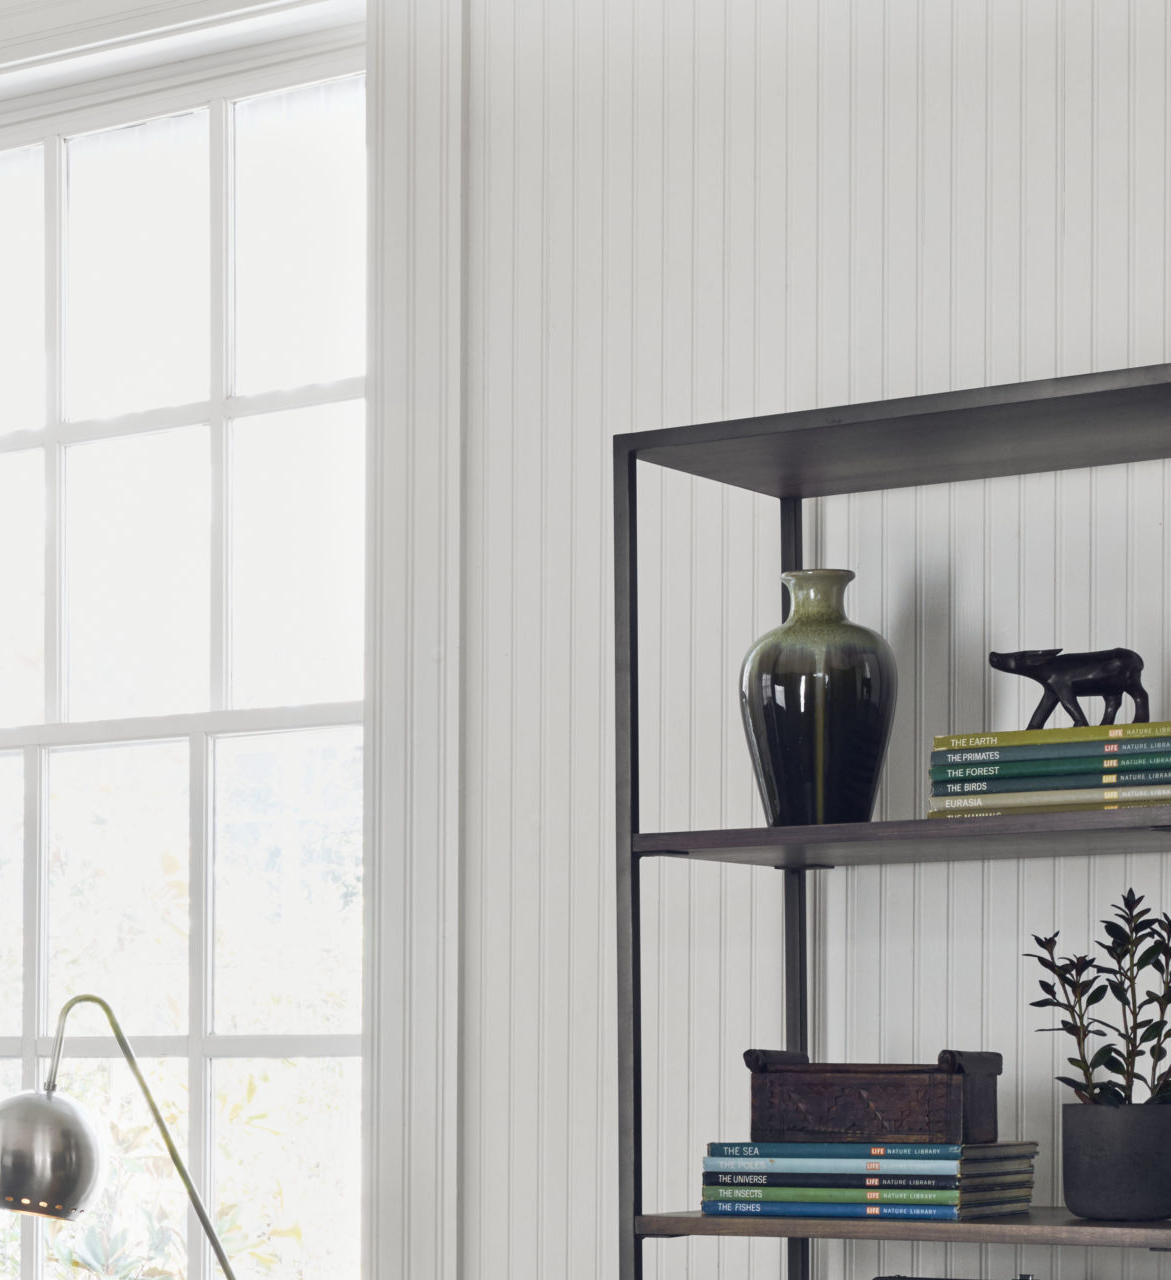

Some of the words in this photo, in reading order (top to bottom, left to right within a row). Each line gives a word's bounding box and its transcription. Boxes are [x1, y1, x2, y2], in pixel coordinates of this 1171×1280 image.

[950, 739, 967, 747] THE
[969, 737, 997, 746] EARTH
[1105, 744, 1118, 752] LIFE
[946, 753, 961, 762] THE
[962, 751, 1000, 761] PRIMATES
[947, 769, 964, 777] THE
[966, 766, 999, 776] FOREST
[1103, 775, 1116, 783] LIFE
[947, 784, 962, 792] THE
[964, 782, 987, 791] BIRDS
[945, 798, 982, 808] EURASIA
[724, 1147, 740, 1155] THE
[743, 1147, 759, 1156] SEA
[719, 1160, 733, 1169] THE
[718, 1174, 731, 1183] THE
[733, 1175, 767, 1184] UNIVERSE
[866, 1178, 879, 1186] LIFE
[719, 1189, 732, 1198] THE
[734, 1189, 762, 1198] INSECTS
[718, 1202, 732, 1211] THE
[735, 1203, 761, 1212] FISHES
